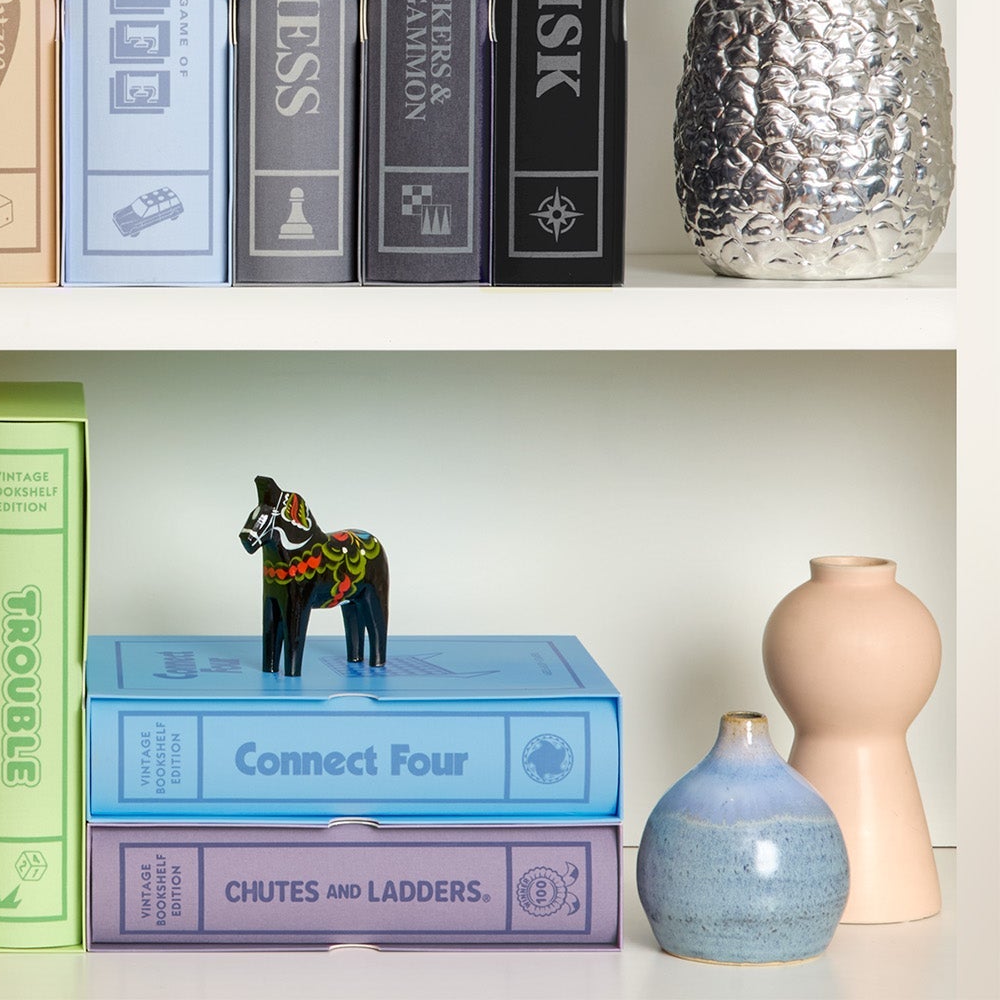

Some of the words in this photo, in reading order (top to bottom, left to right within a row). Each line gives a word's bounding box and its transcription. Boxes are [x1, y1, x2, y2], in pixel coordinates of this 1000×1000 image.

[179, 56, 189, 78] OF
[431, 83, 452, 106] &
[0, 585, 41, 787] TROUBLE
[140, 731, 151, 787] VINTAGE
[155, 721, 166, 795] BOOKSHELF
[170, 733, 182, 785] EDITION
[235, 742, 378, 776] Connect
[391, 744, 468, 777] Four
[140, 863, 152, 919] VINTAGE
[155, 853, 167, 926] BOOKSHELF
[171, 865, 182, 917] EDITION
[225, 880, 319, 903] CHUTES
[327, 882, 362, 901] AND
[536, 881, 547, 904] 100
